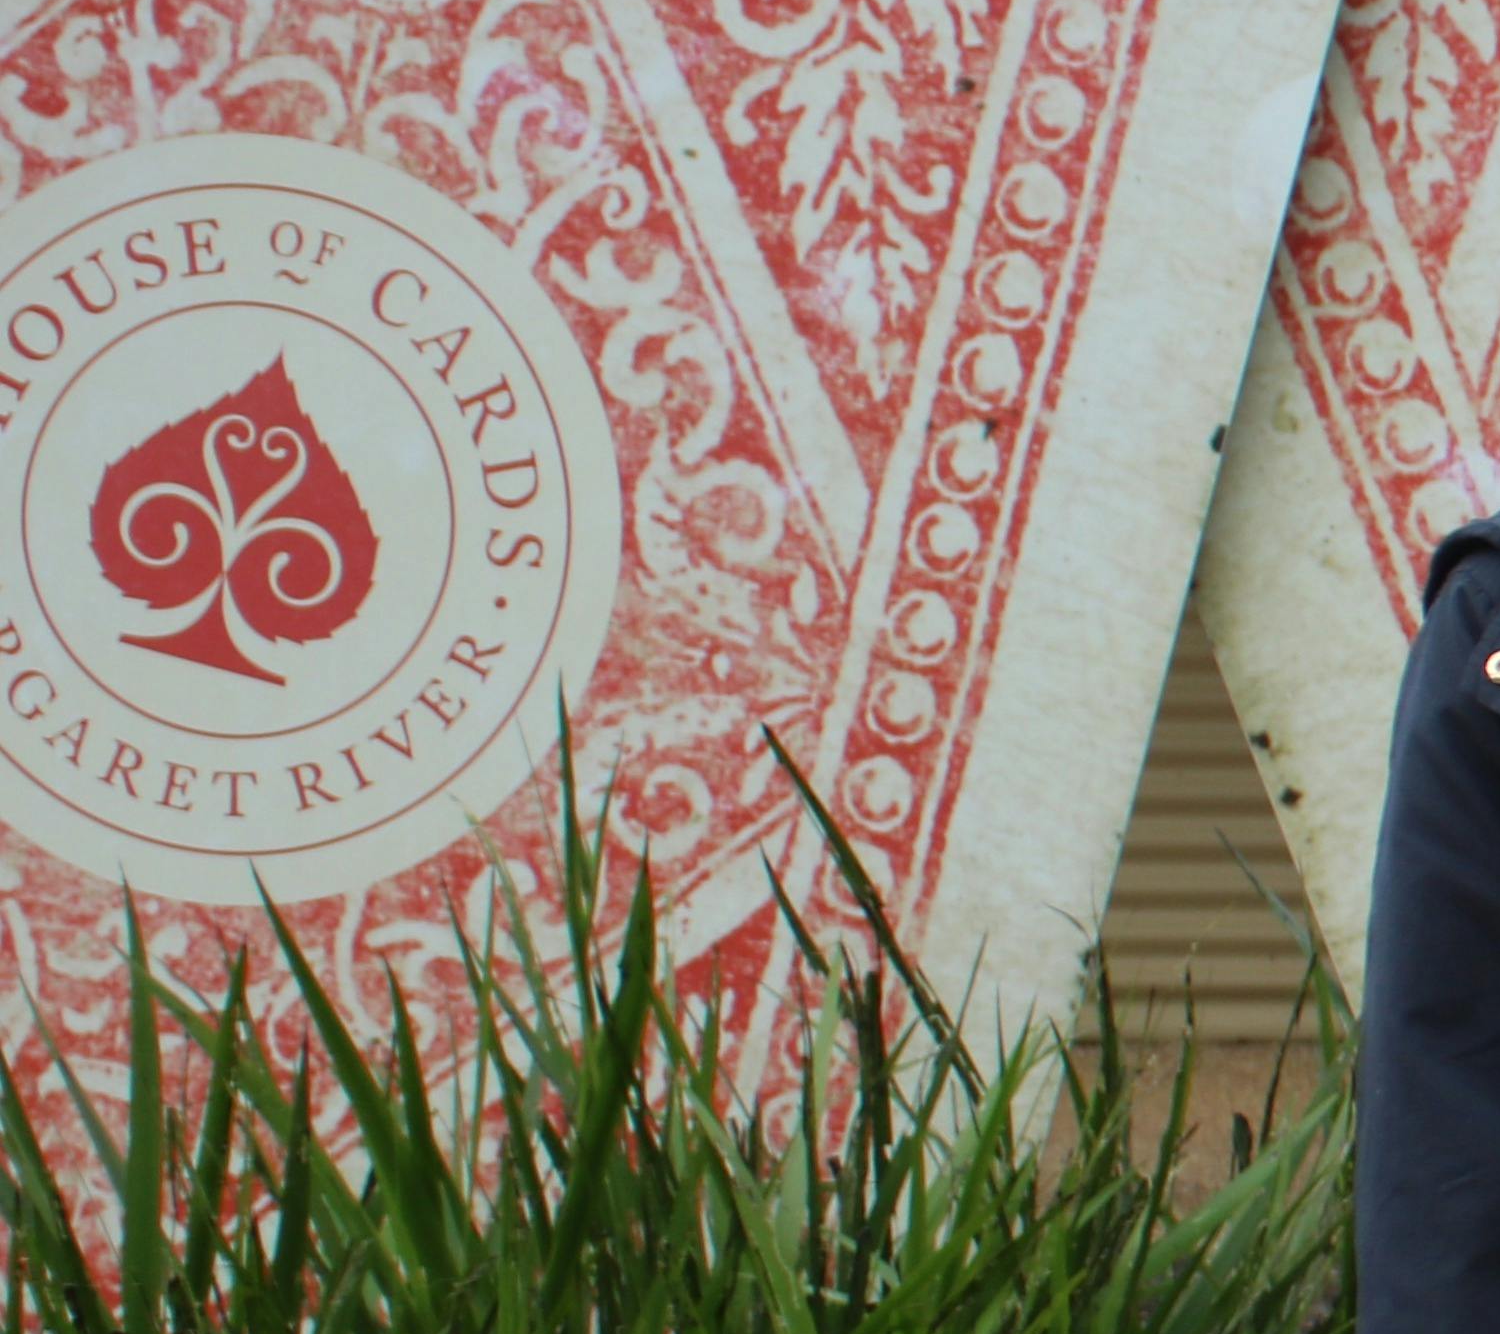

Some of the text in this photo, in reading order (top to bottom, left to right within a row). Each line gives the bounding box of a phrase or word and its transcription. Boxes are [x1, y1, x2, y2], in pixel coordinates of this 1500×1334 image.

[269, 220, 346, 266] OF
[370, 269, 545, 570] CARDS
[286, 634, 506, 812] RIVER
